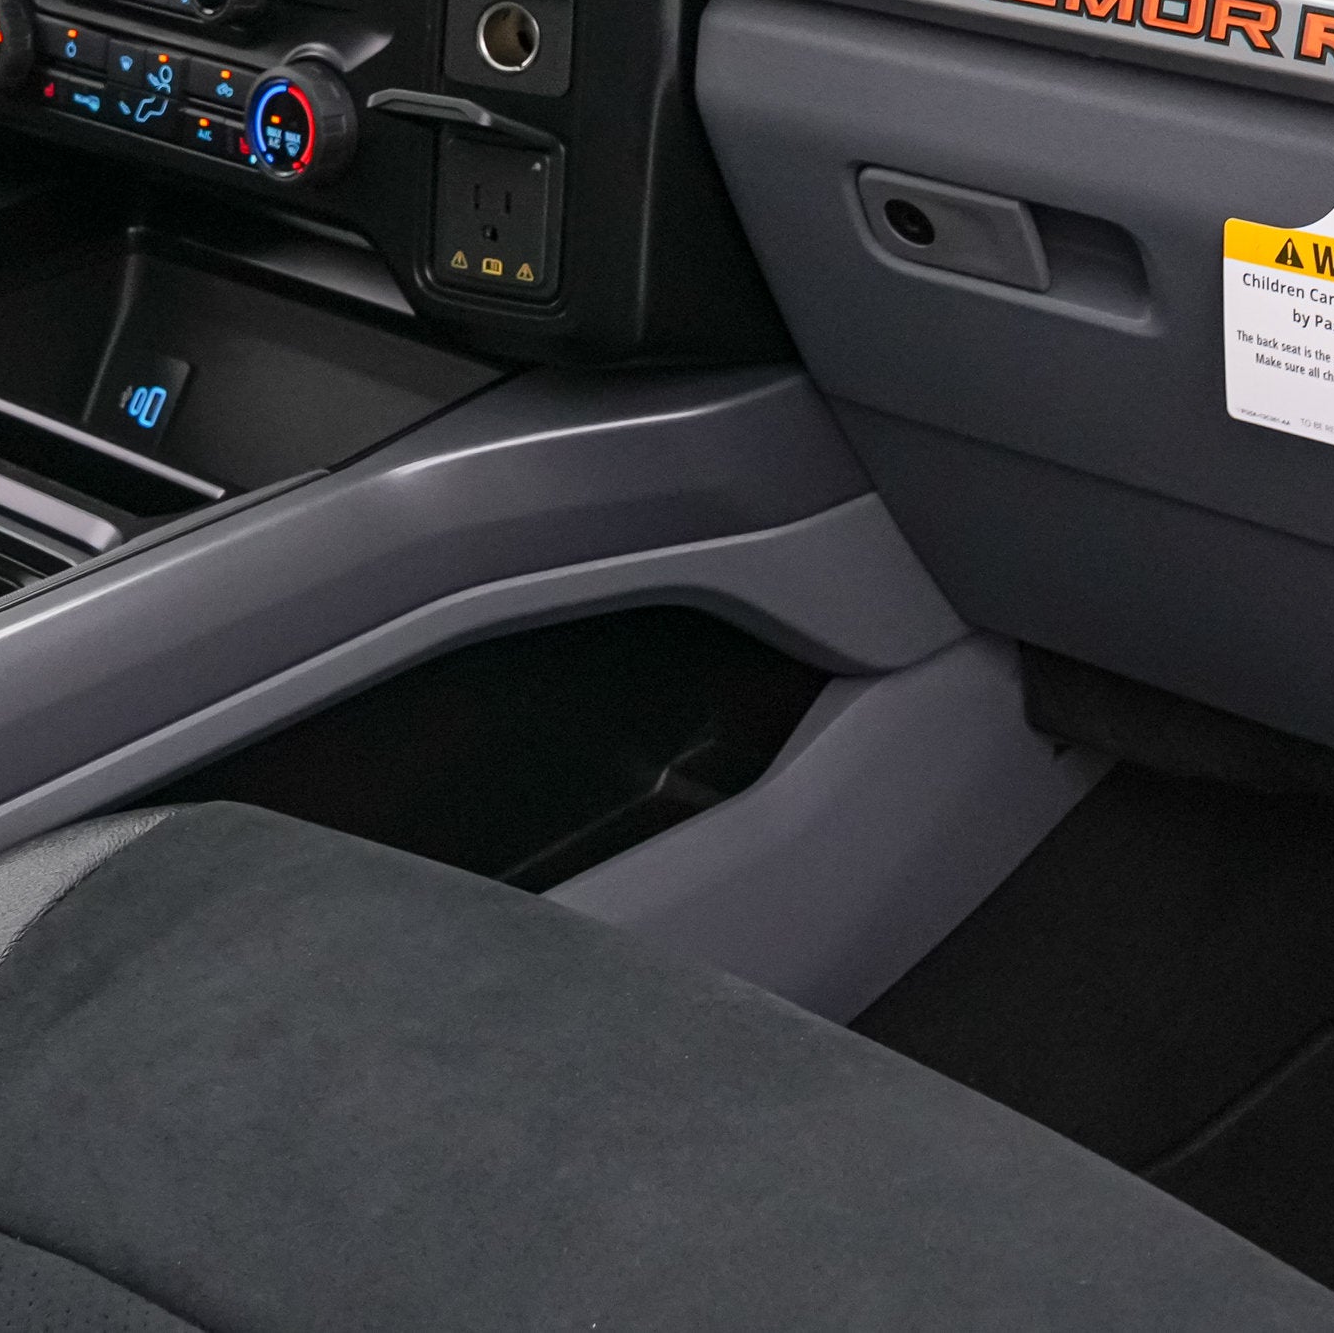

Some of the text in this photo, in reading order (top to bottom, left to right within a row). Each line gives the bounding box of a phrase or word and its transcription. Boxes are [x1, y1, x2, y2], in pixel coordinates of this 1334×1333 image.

[1242, 272, 1305, 299] Children
[1293, 308, 1311, 329] by
[1236, 329, 1254, 344] The
[1256, 333, 1279, 350] back
[1281, 342, 1301, 356] seat
[1304, 345, 1312, 359] is
[1314, 349, 1331, 363] the
[1255, 352, 1282, 369] Make
[1284, 362, 1306, 375] sure
[1308, 366, 1320, 379] all
